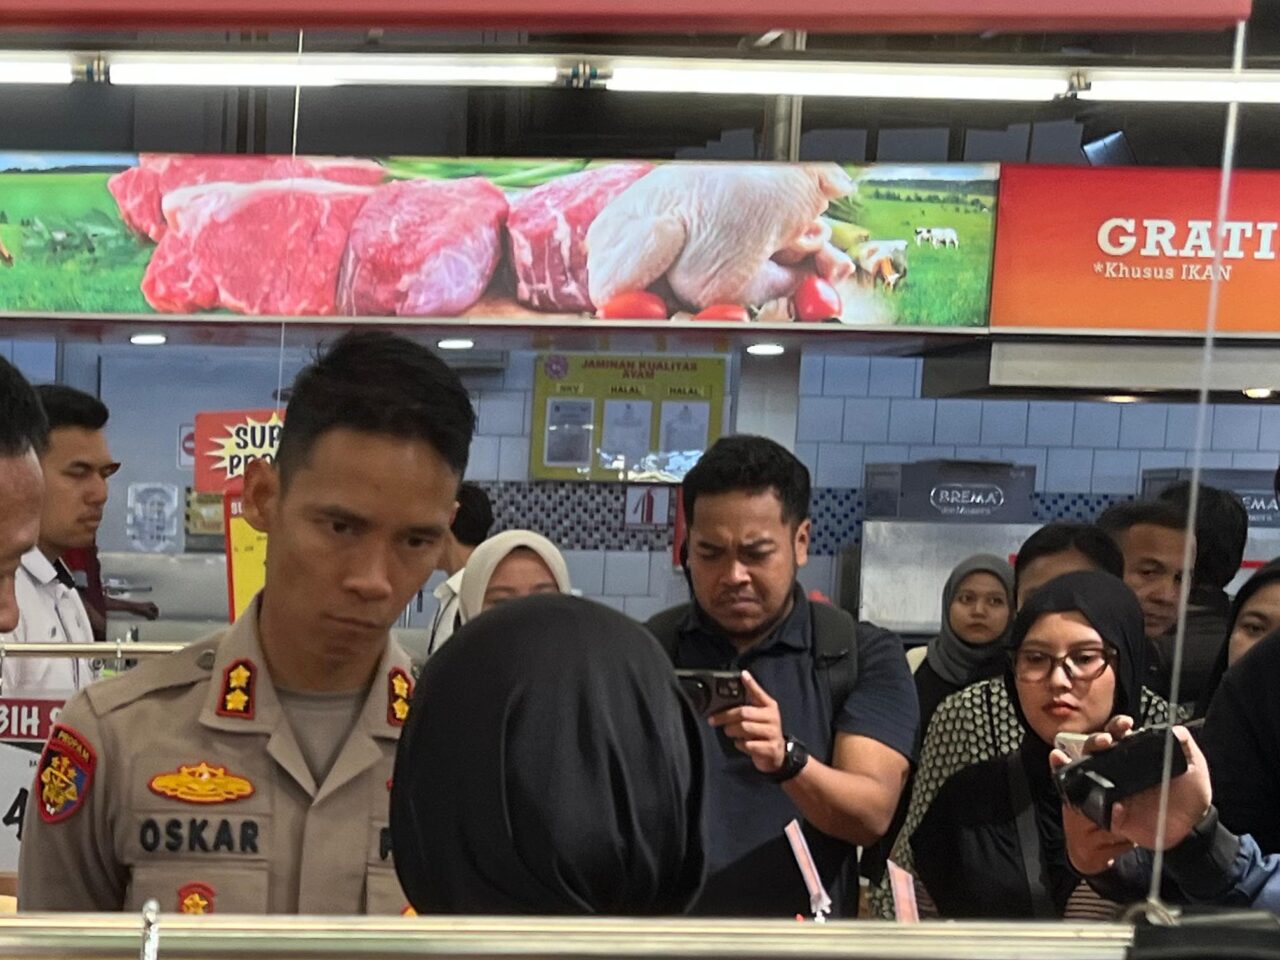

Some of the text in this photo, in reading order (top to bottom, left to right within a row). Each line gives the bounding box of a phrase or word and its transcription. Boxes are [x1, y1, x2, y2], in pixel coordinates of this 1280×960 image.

[1181, 264, 1232, 281] IKAN
[582, 359, 698, 372] JAMINAN KUALITAS
[611, 386, 641, 394] HALAL
[235, 425, 282, 449] SUP
[939, 489, 997, 504] BREMA
[140, 818, 259, 853] OSKAR
